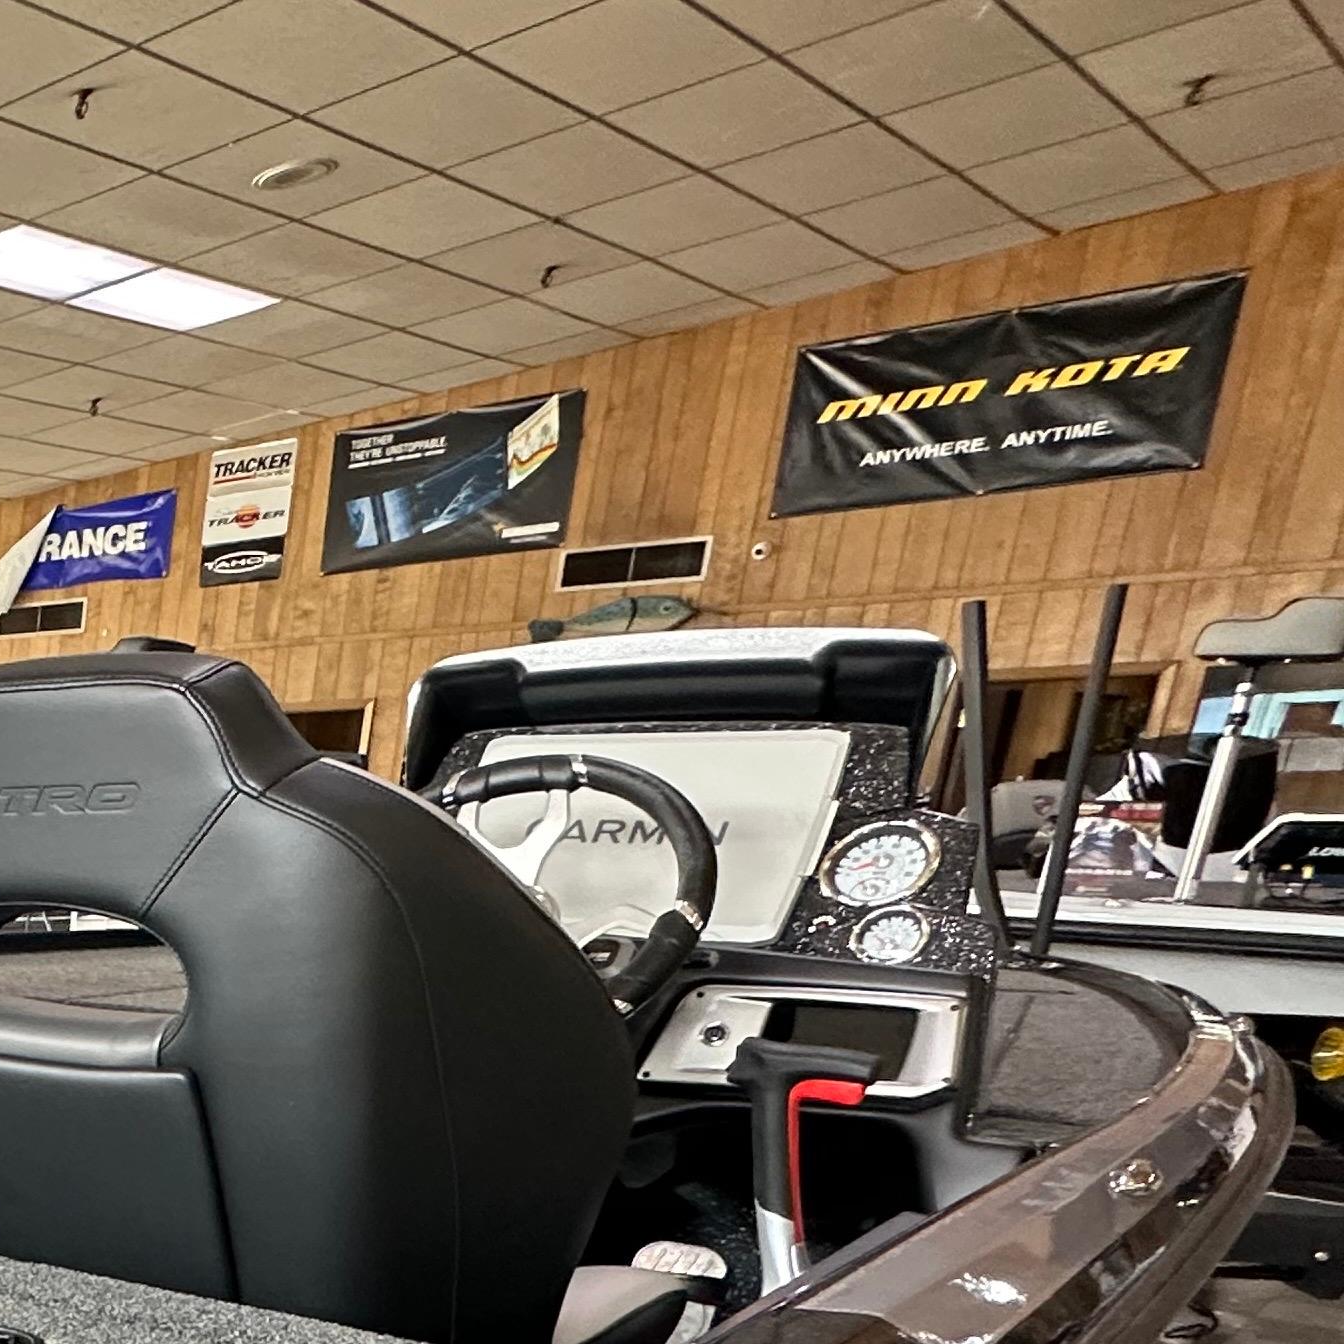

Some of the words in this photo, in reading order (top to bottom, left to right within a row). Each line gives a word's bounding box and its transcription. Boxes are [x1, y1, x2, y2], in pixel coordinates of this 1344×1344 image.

[1004, 346, 1192, 397] KOTA
[858, 436, 990, 468] ANYWHERE.
[999, 419, 1114, 450] ANYTIME.
[213, 451, 293, 479] TRACKER
[525, 818, 730, 847] ARMN
